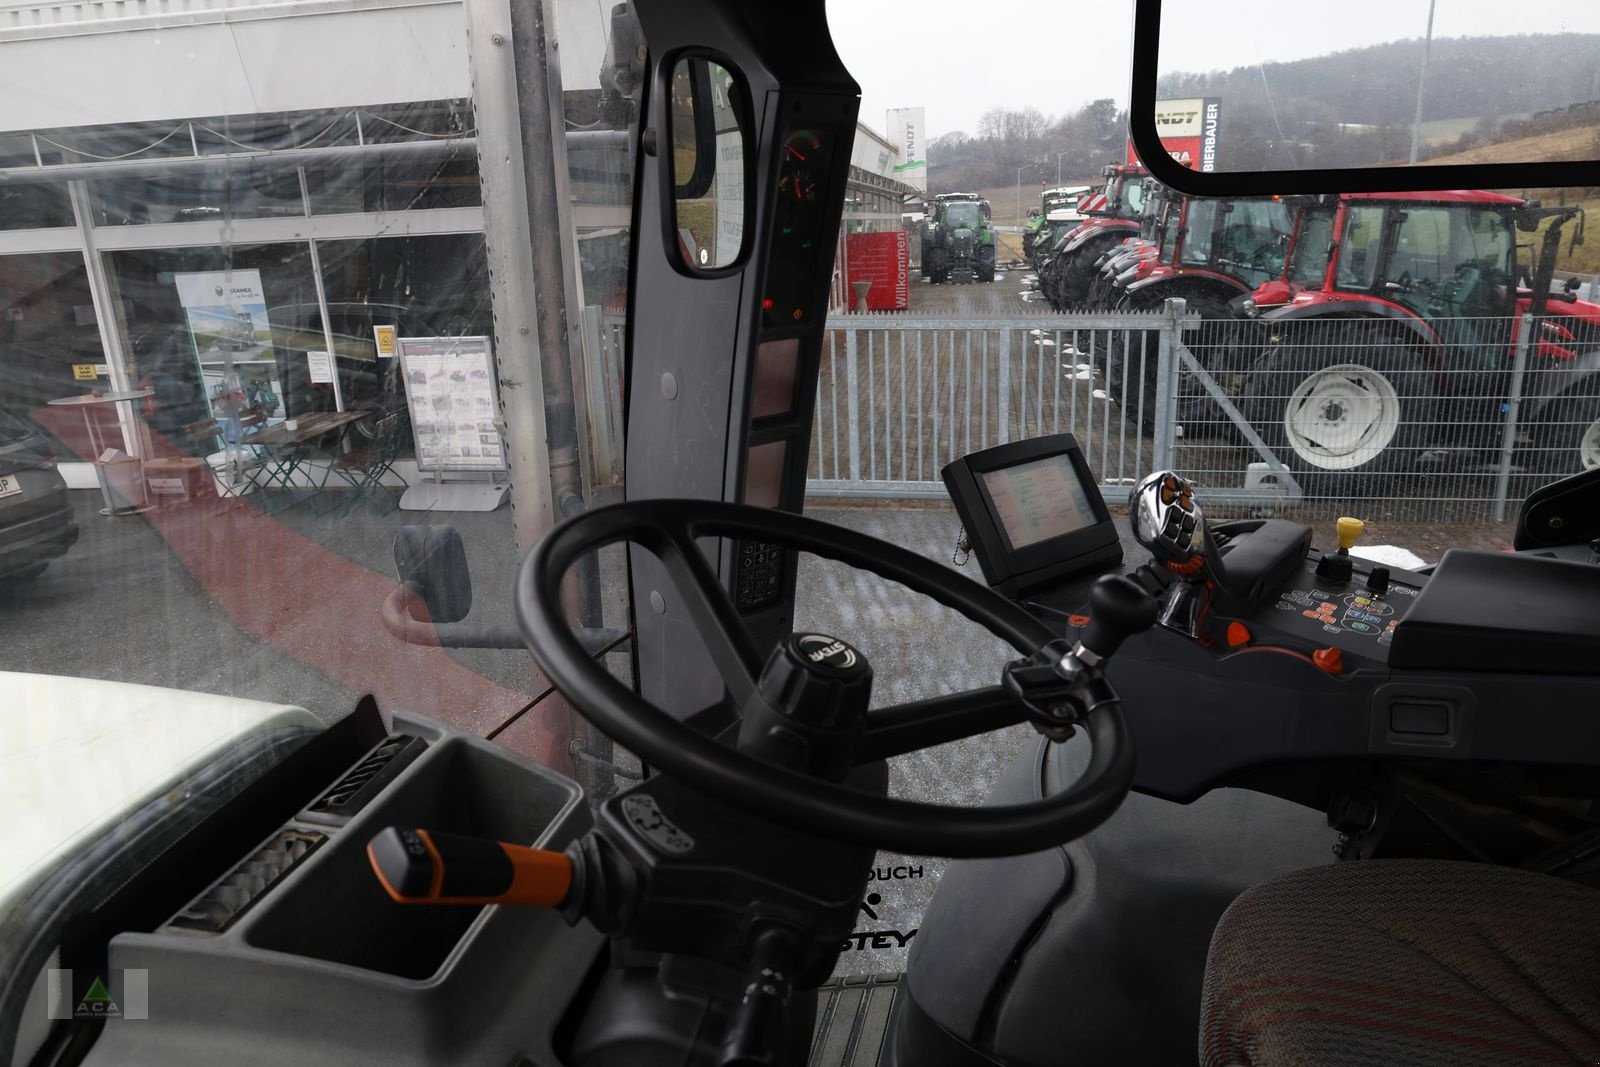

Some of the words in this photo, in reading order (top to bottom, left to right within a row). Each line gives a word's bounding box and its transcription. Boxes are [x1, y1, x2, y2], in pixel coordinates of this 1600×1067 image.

[1157, 112, 1198, 125] NDT
[906, 121, 915, 163] FENDT
[1203, 104, 1219, 172] BIERBAUER
[896, 232, 907, 308] Willkommen
[808, 641, 846, 663] STEYR
[840, 928, 919, 952] STEY
